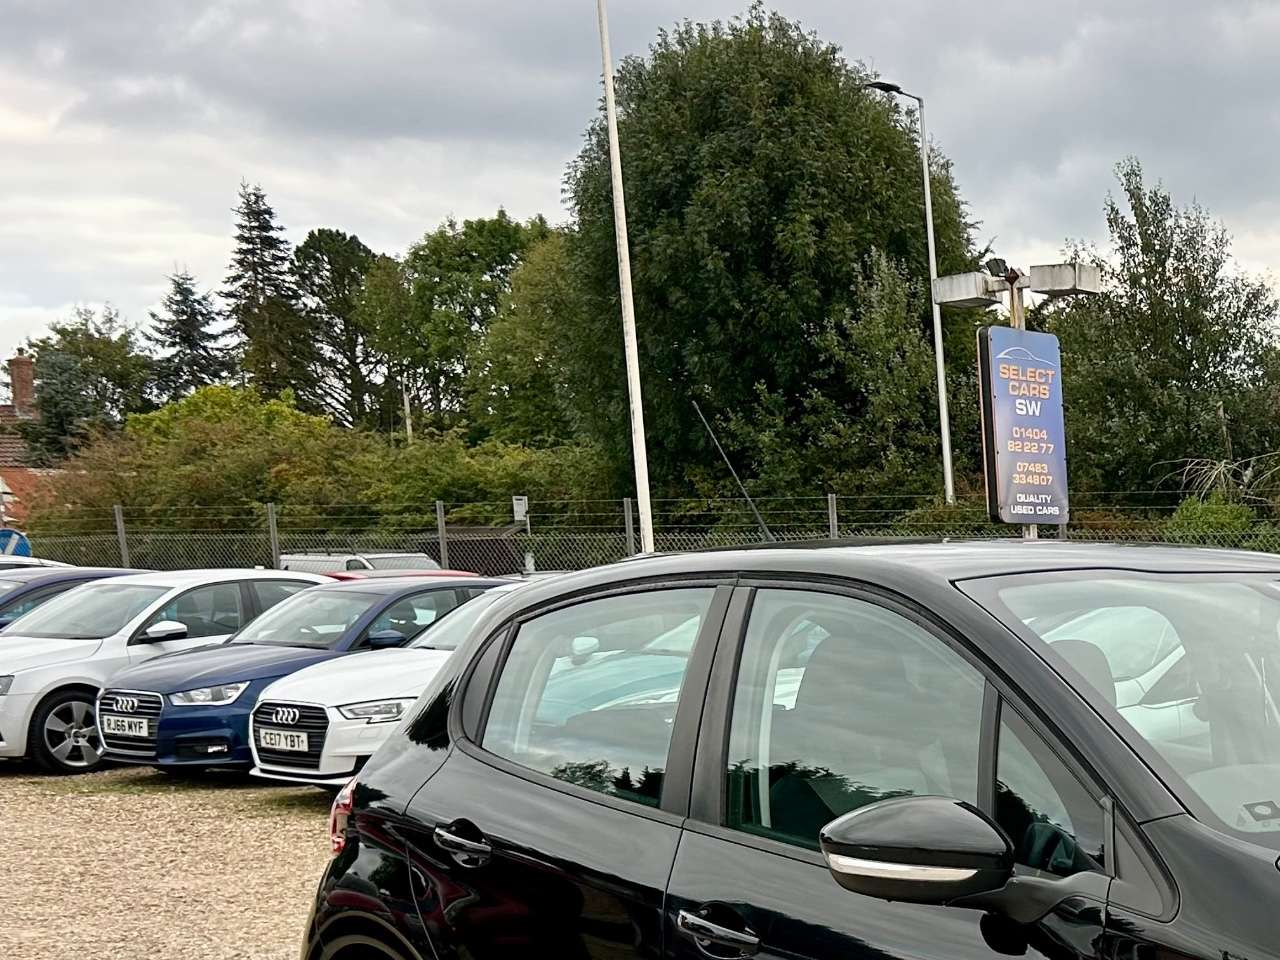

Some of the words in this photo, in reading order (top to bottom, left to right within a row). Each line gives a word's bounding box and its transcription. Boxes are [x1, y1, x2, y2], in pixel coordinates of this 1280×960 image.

[999, 364, 1055, 383] SELECT
[1008, 382, 1050, 399] CARS
[1015, 399, 1041, 416] SW
[1012, 426, 1048, 441] 01404
[1016, 462, 1048, 474] 07483
[1012, 473, 1053, 486] 334807
[1016, 493, 1051, 504] QUALITY
[1010, 504, 1035, 515] USED
[1036, 505, 1060, 516] CARS
[106, 718, 127, 732] RJ66
[282, 734, 302, 749] YBT
